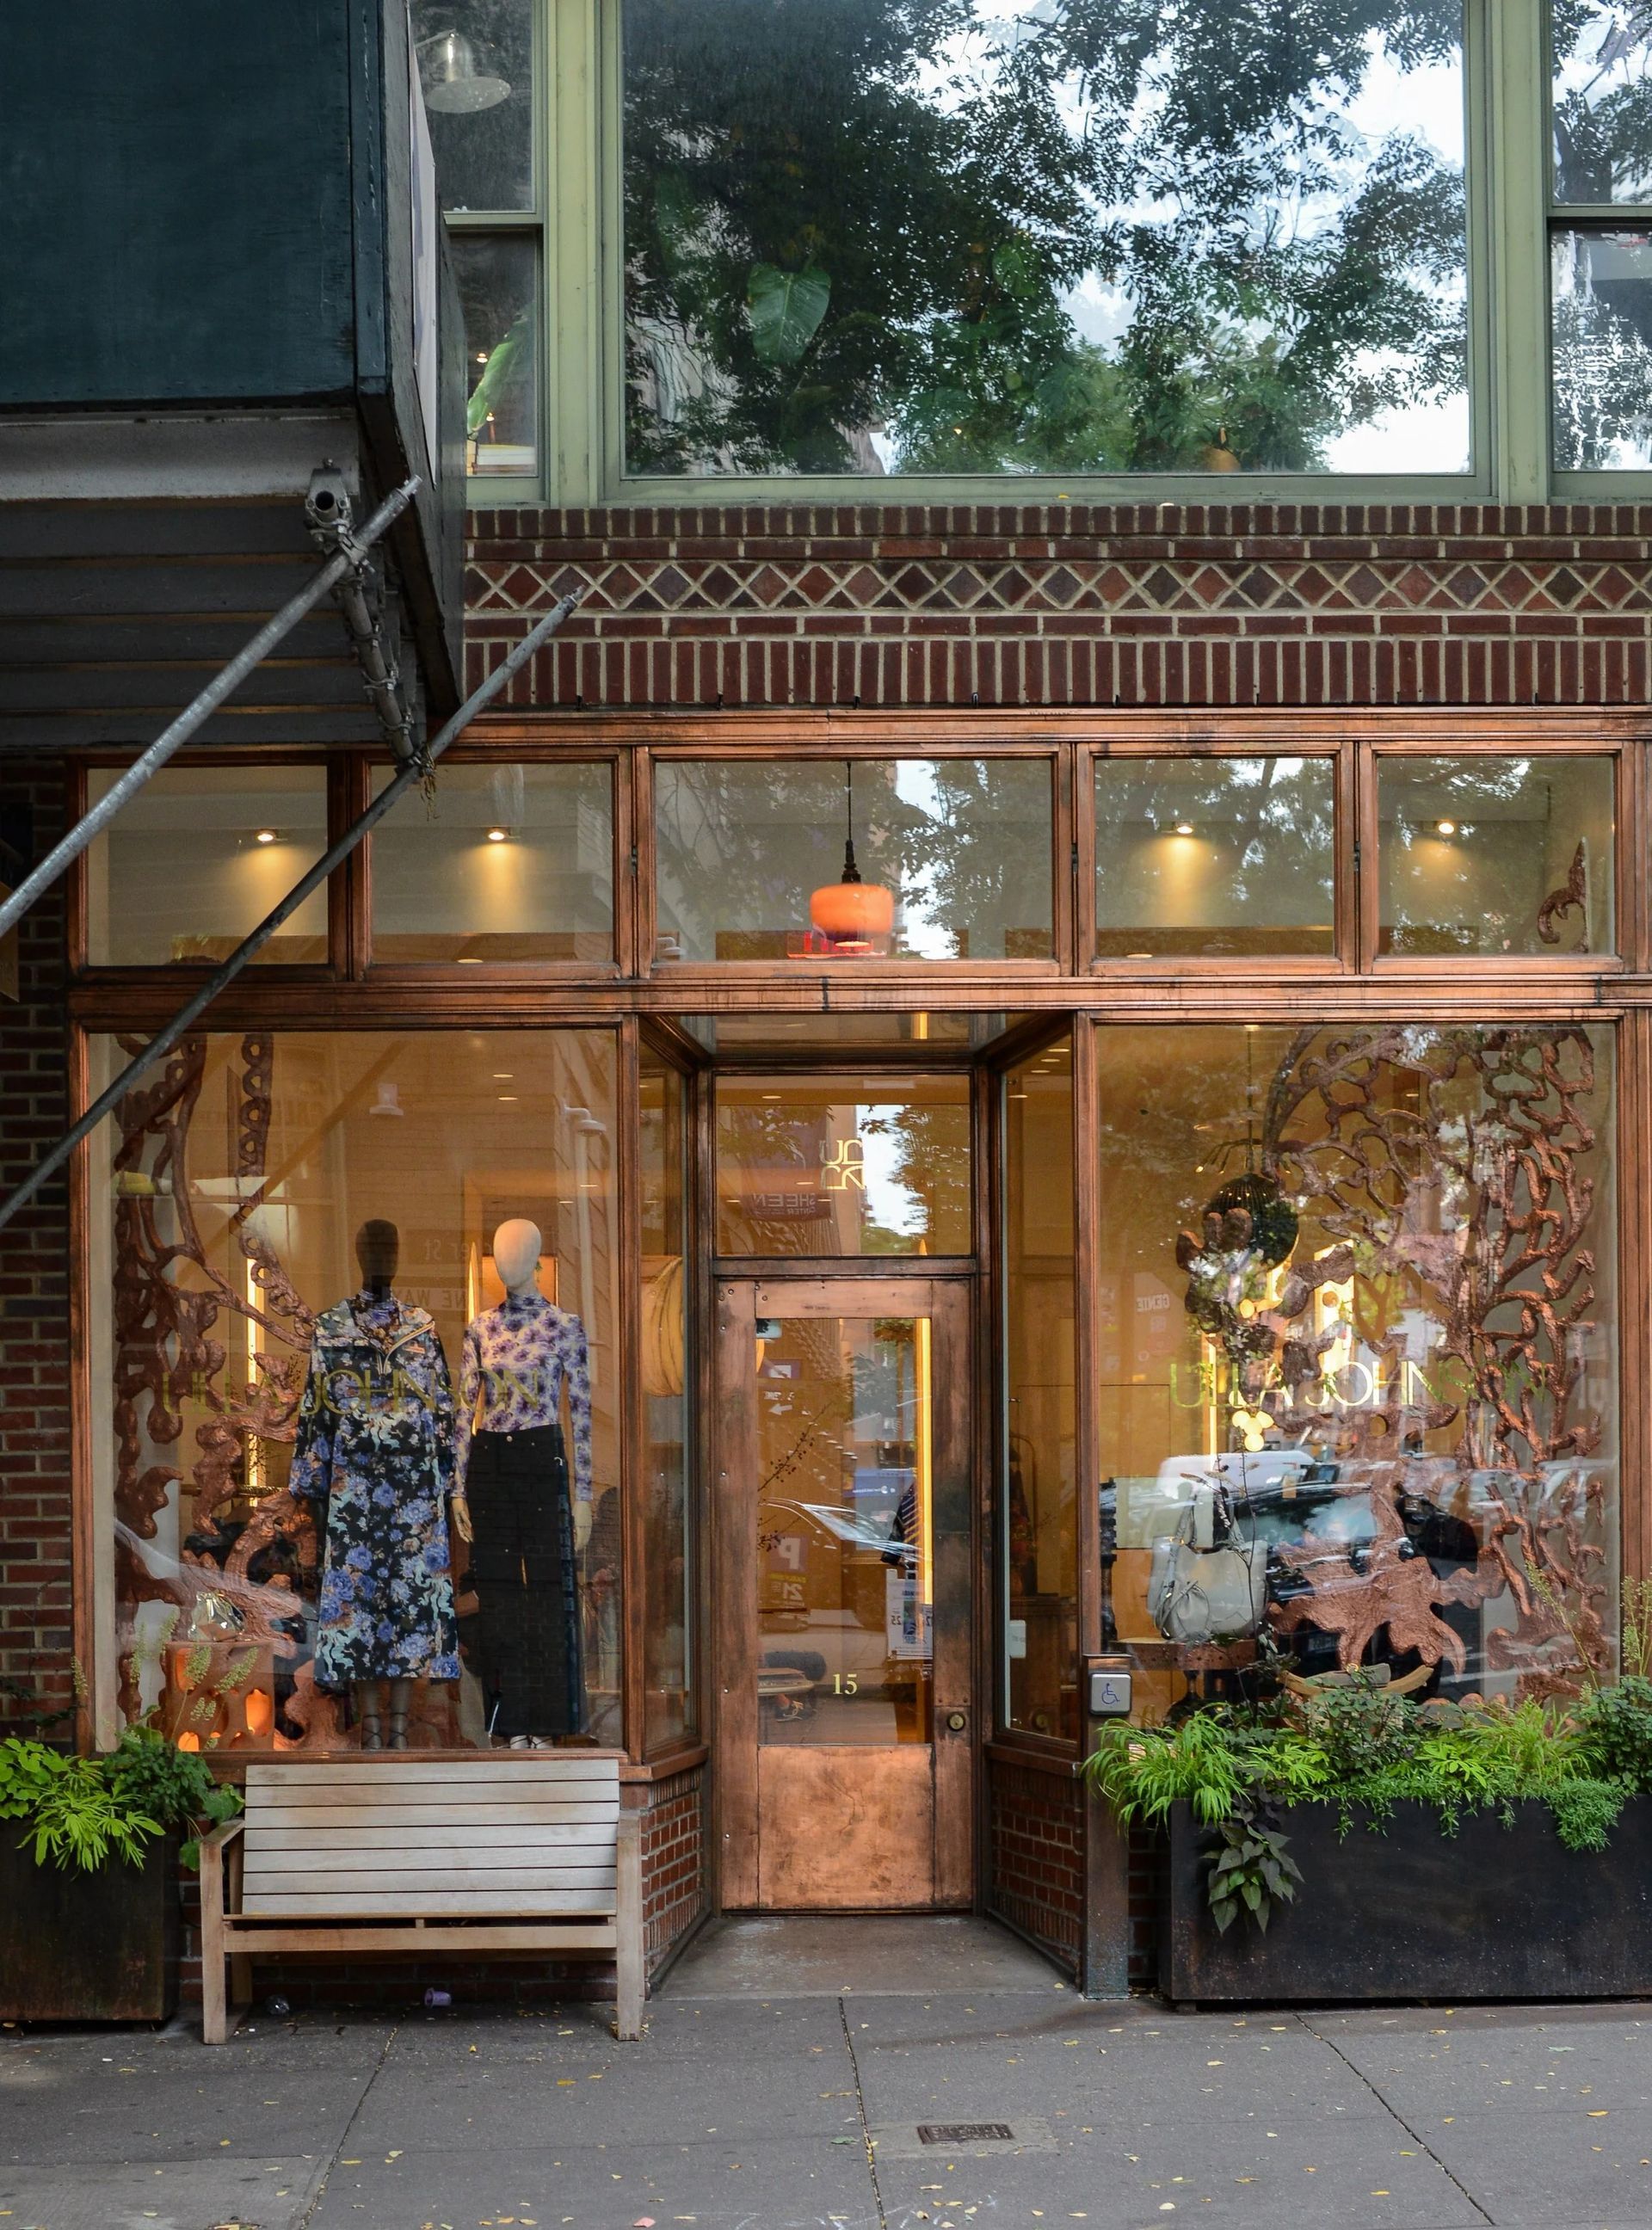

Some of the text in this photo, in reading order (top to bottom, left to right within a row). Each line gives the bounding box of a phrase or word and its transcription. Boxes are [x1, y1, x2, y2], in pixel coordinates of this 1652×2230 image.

[162, 1369, 539, 1416] ULLA JOHNSON
[1169, 1360, 1546, 1408] ULLA JOHNSON
[832, 1673, 858, 1695] 15
